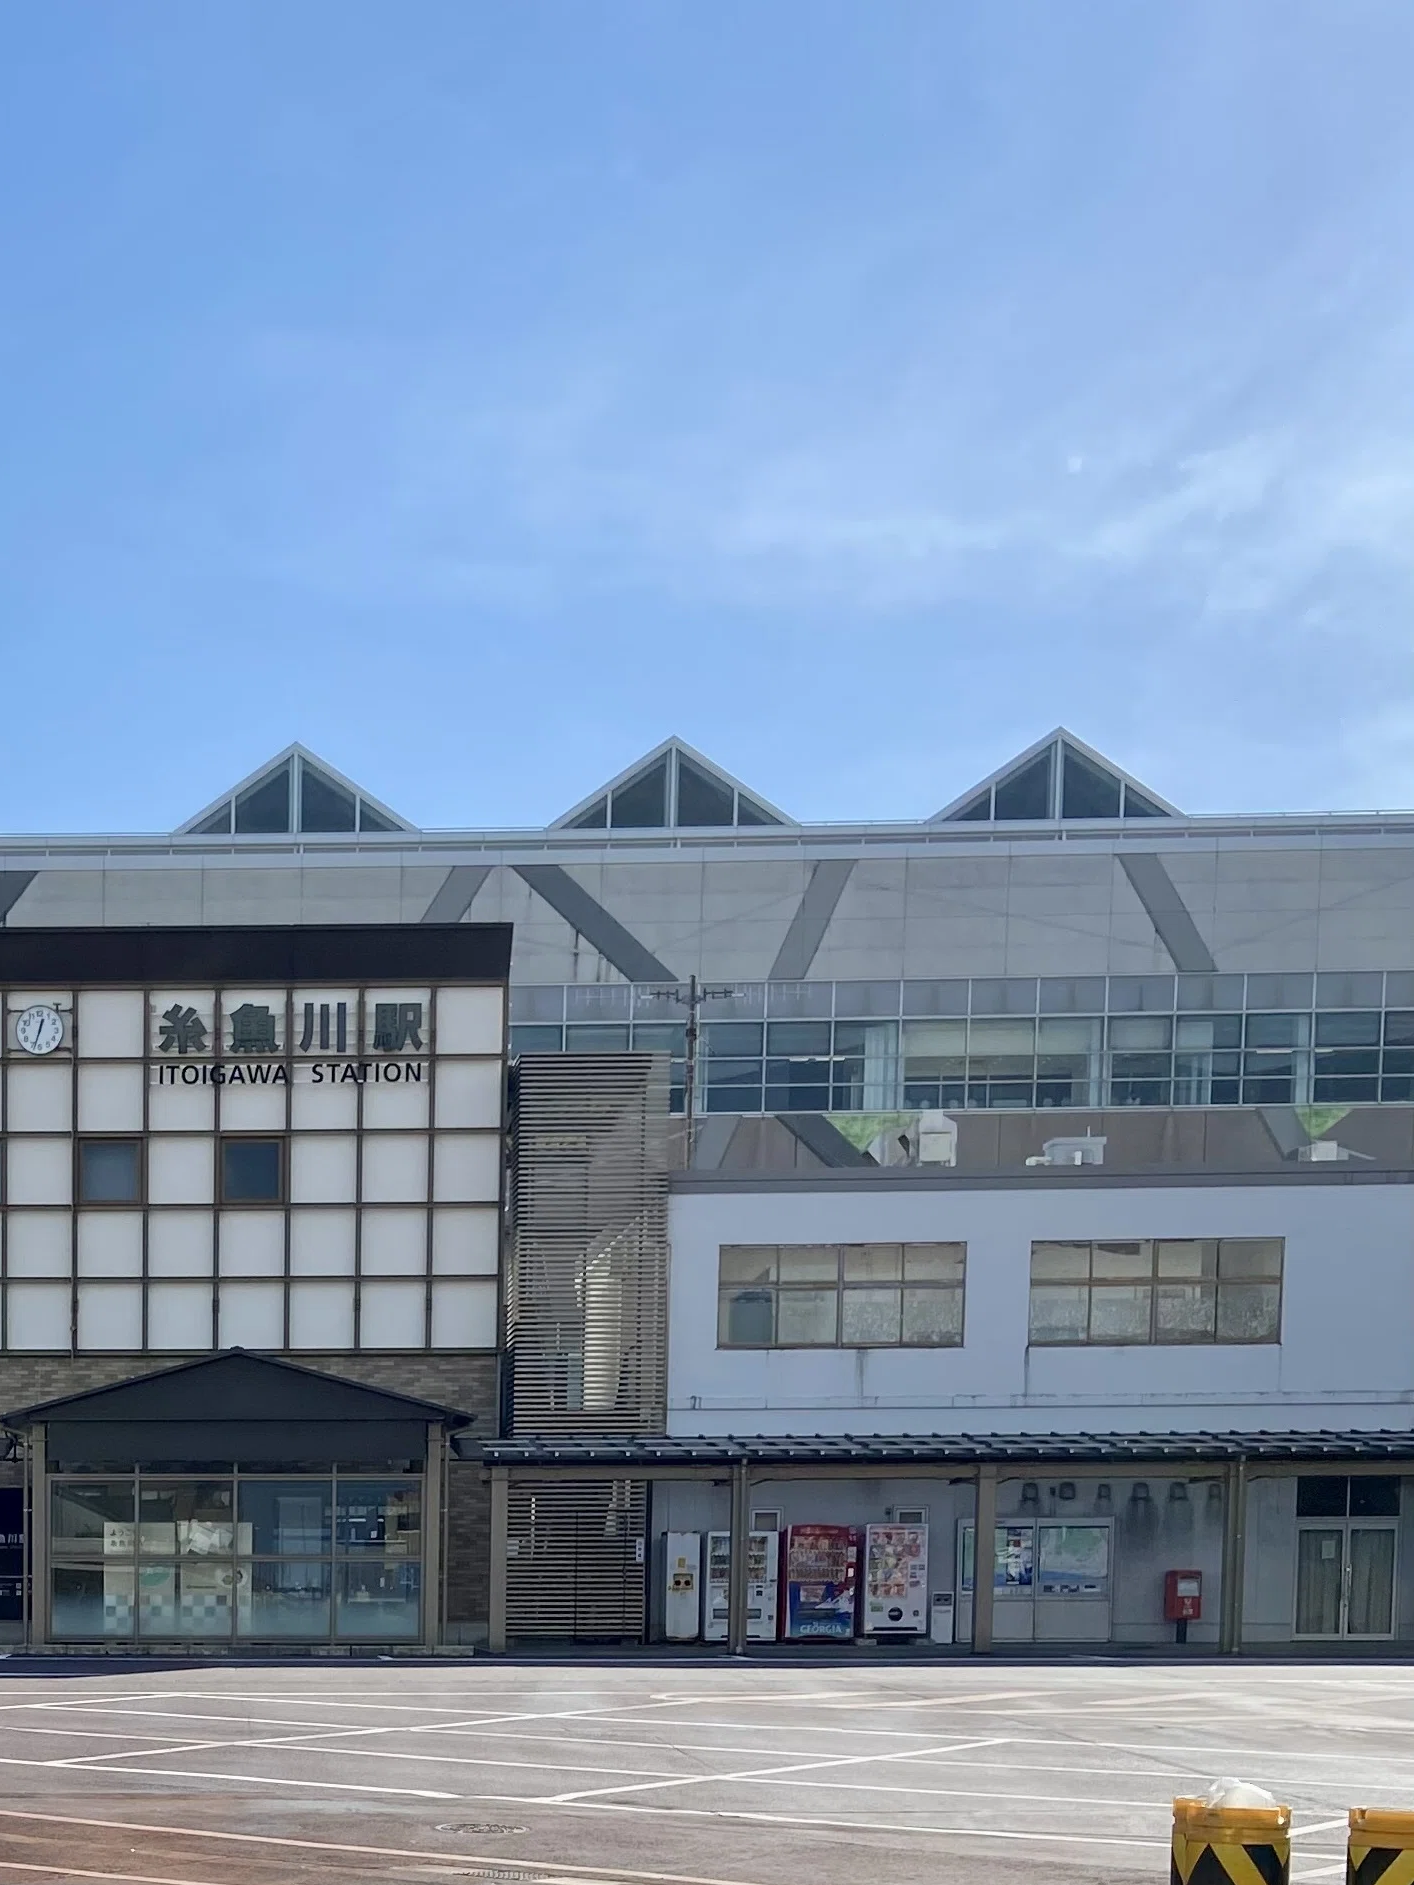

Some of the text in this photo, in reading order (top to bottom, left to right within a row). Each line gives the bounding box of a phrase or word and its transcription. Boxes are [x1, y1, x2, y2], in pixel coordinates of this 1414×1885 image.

[158, 1002, 423, 1053] 糸魚川駅
[159, 1062, 421, 1085] ITOIGAWA STATION
